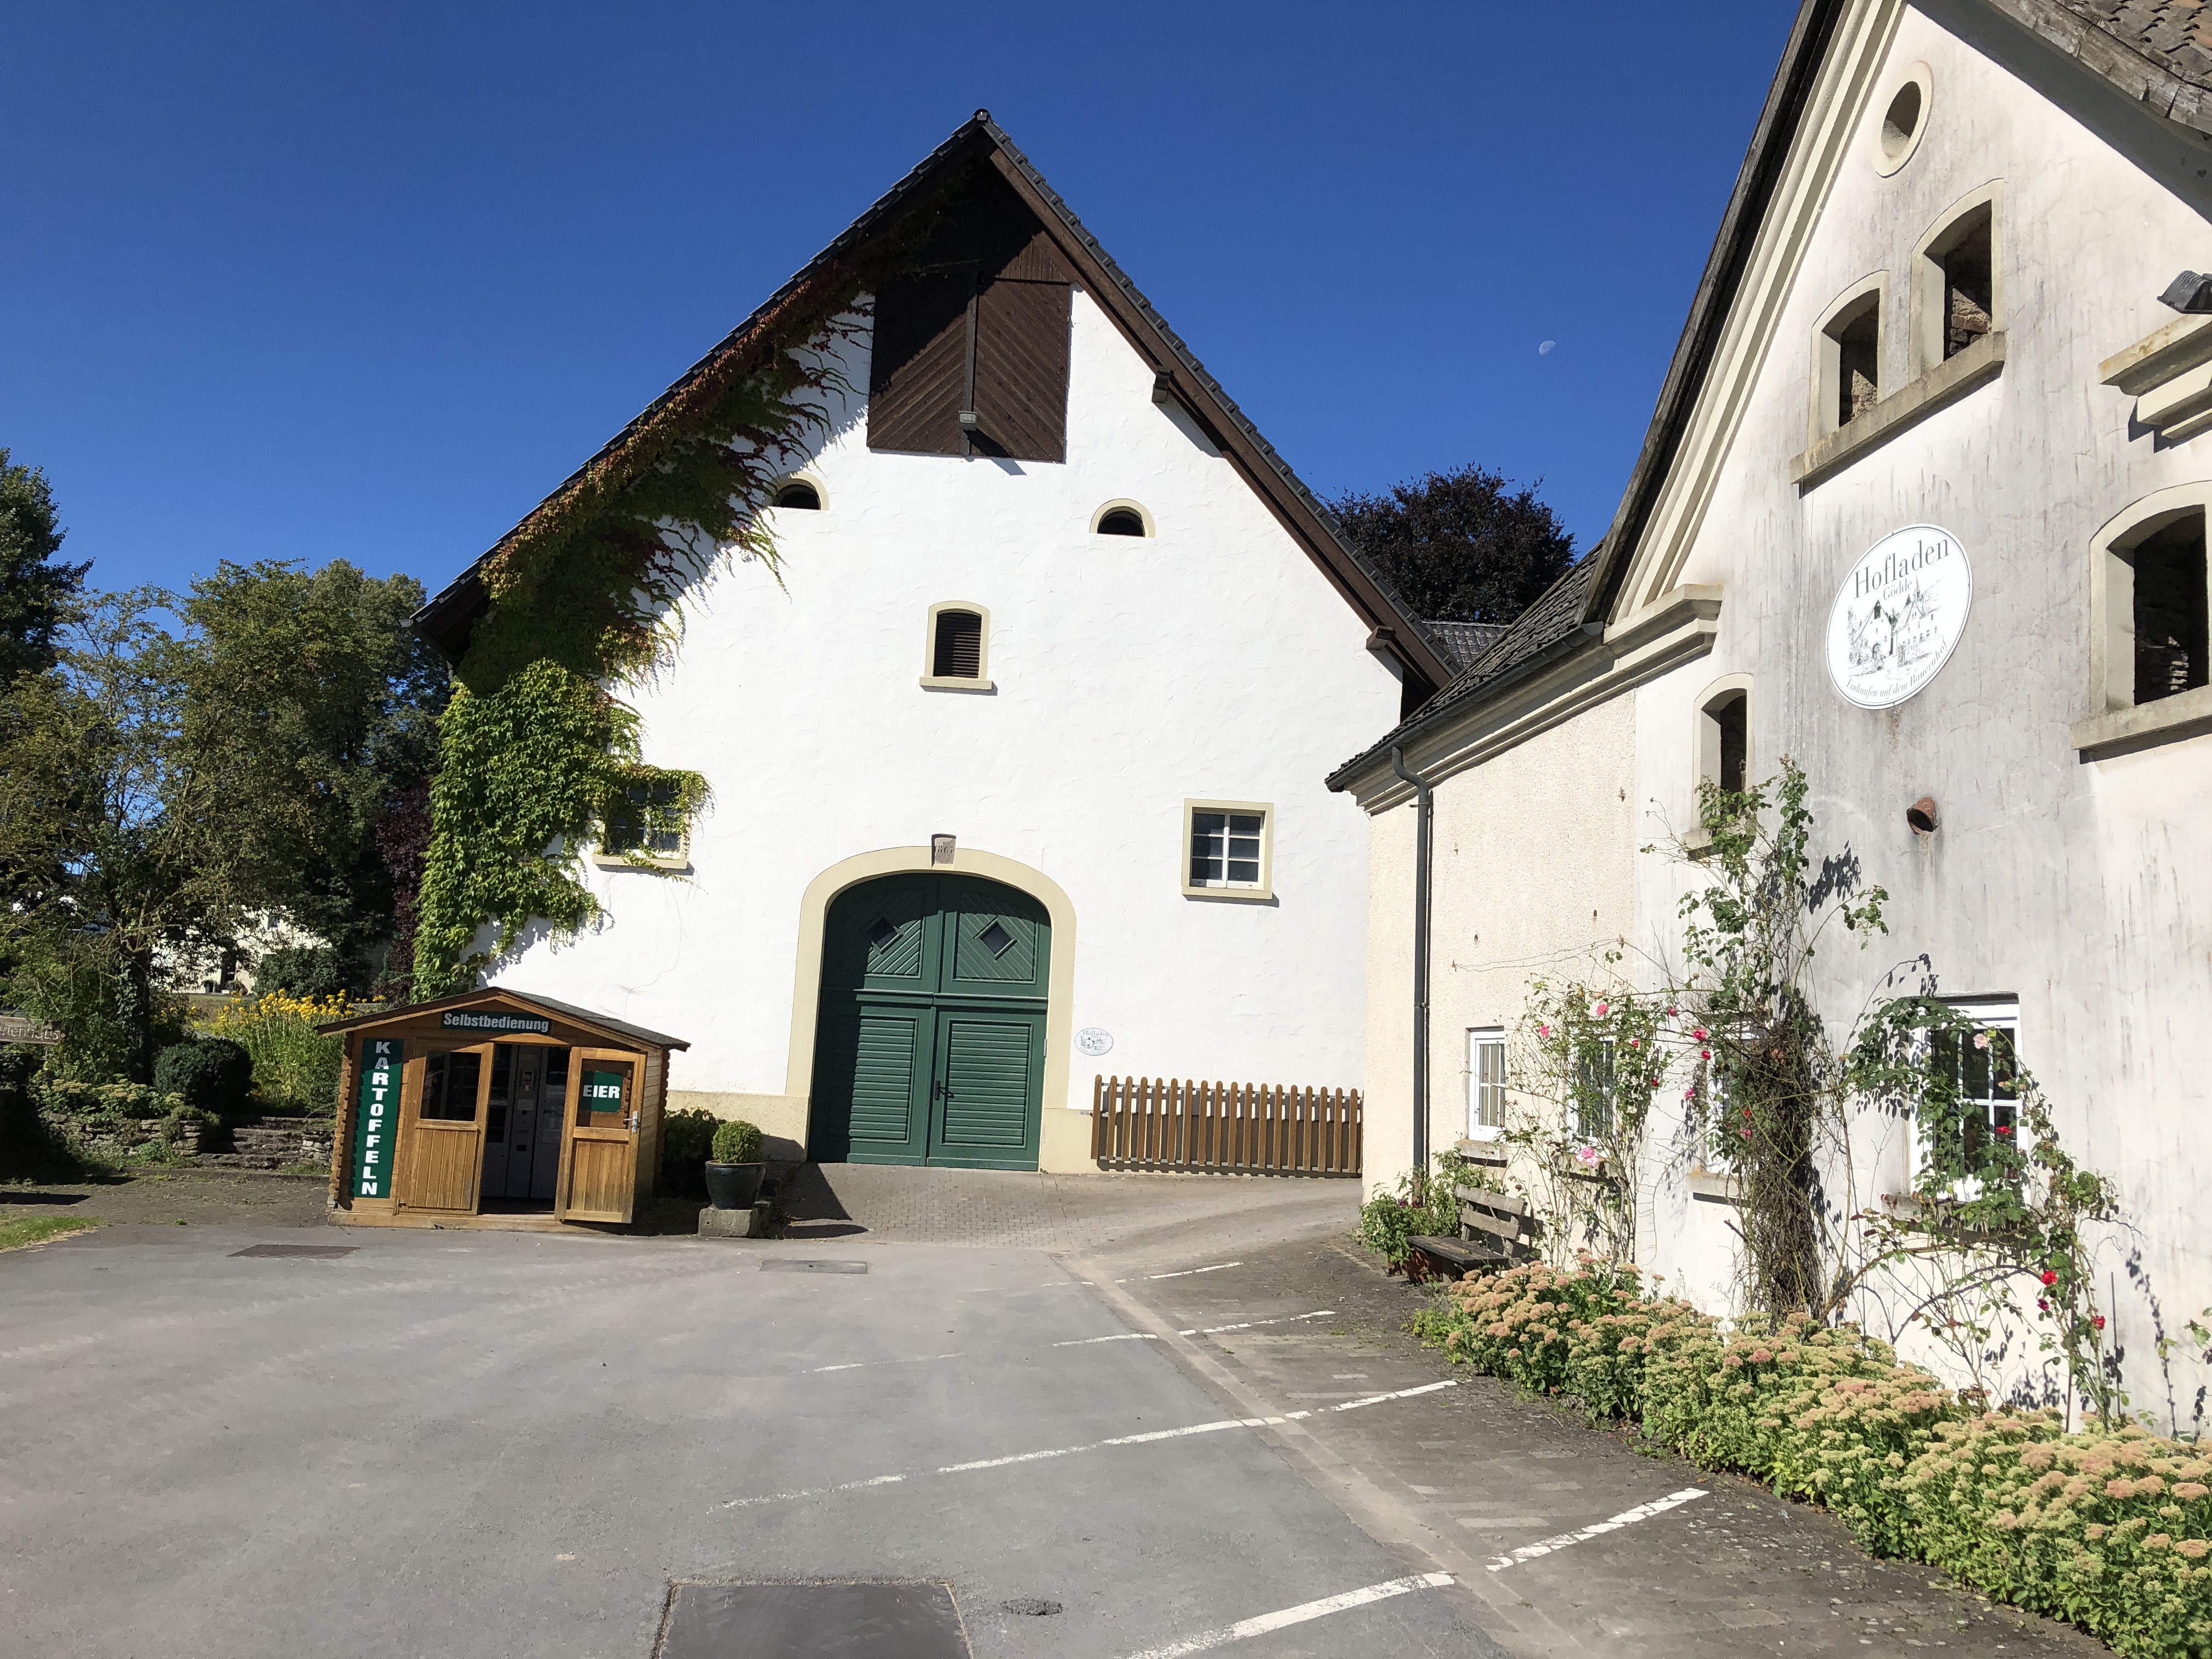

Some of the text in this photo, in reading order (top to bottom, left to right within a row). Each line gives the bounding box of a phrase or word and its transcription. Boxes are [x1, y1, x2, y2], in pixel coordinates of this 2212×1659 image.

[1854, 539, 1950, 600] Hofladen
[1883, 578, 1912, 601] Gödde
[1846, 636, 1948, 699] Einkaufen auf dem Bauernhof
[443, 1013, 549, 1032] Selbstbedienung
[583, 1085, 620, 1099] EIER
[362, 1041, 391, 1195] KARTOFFELN
